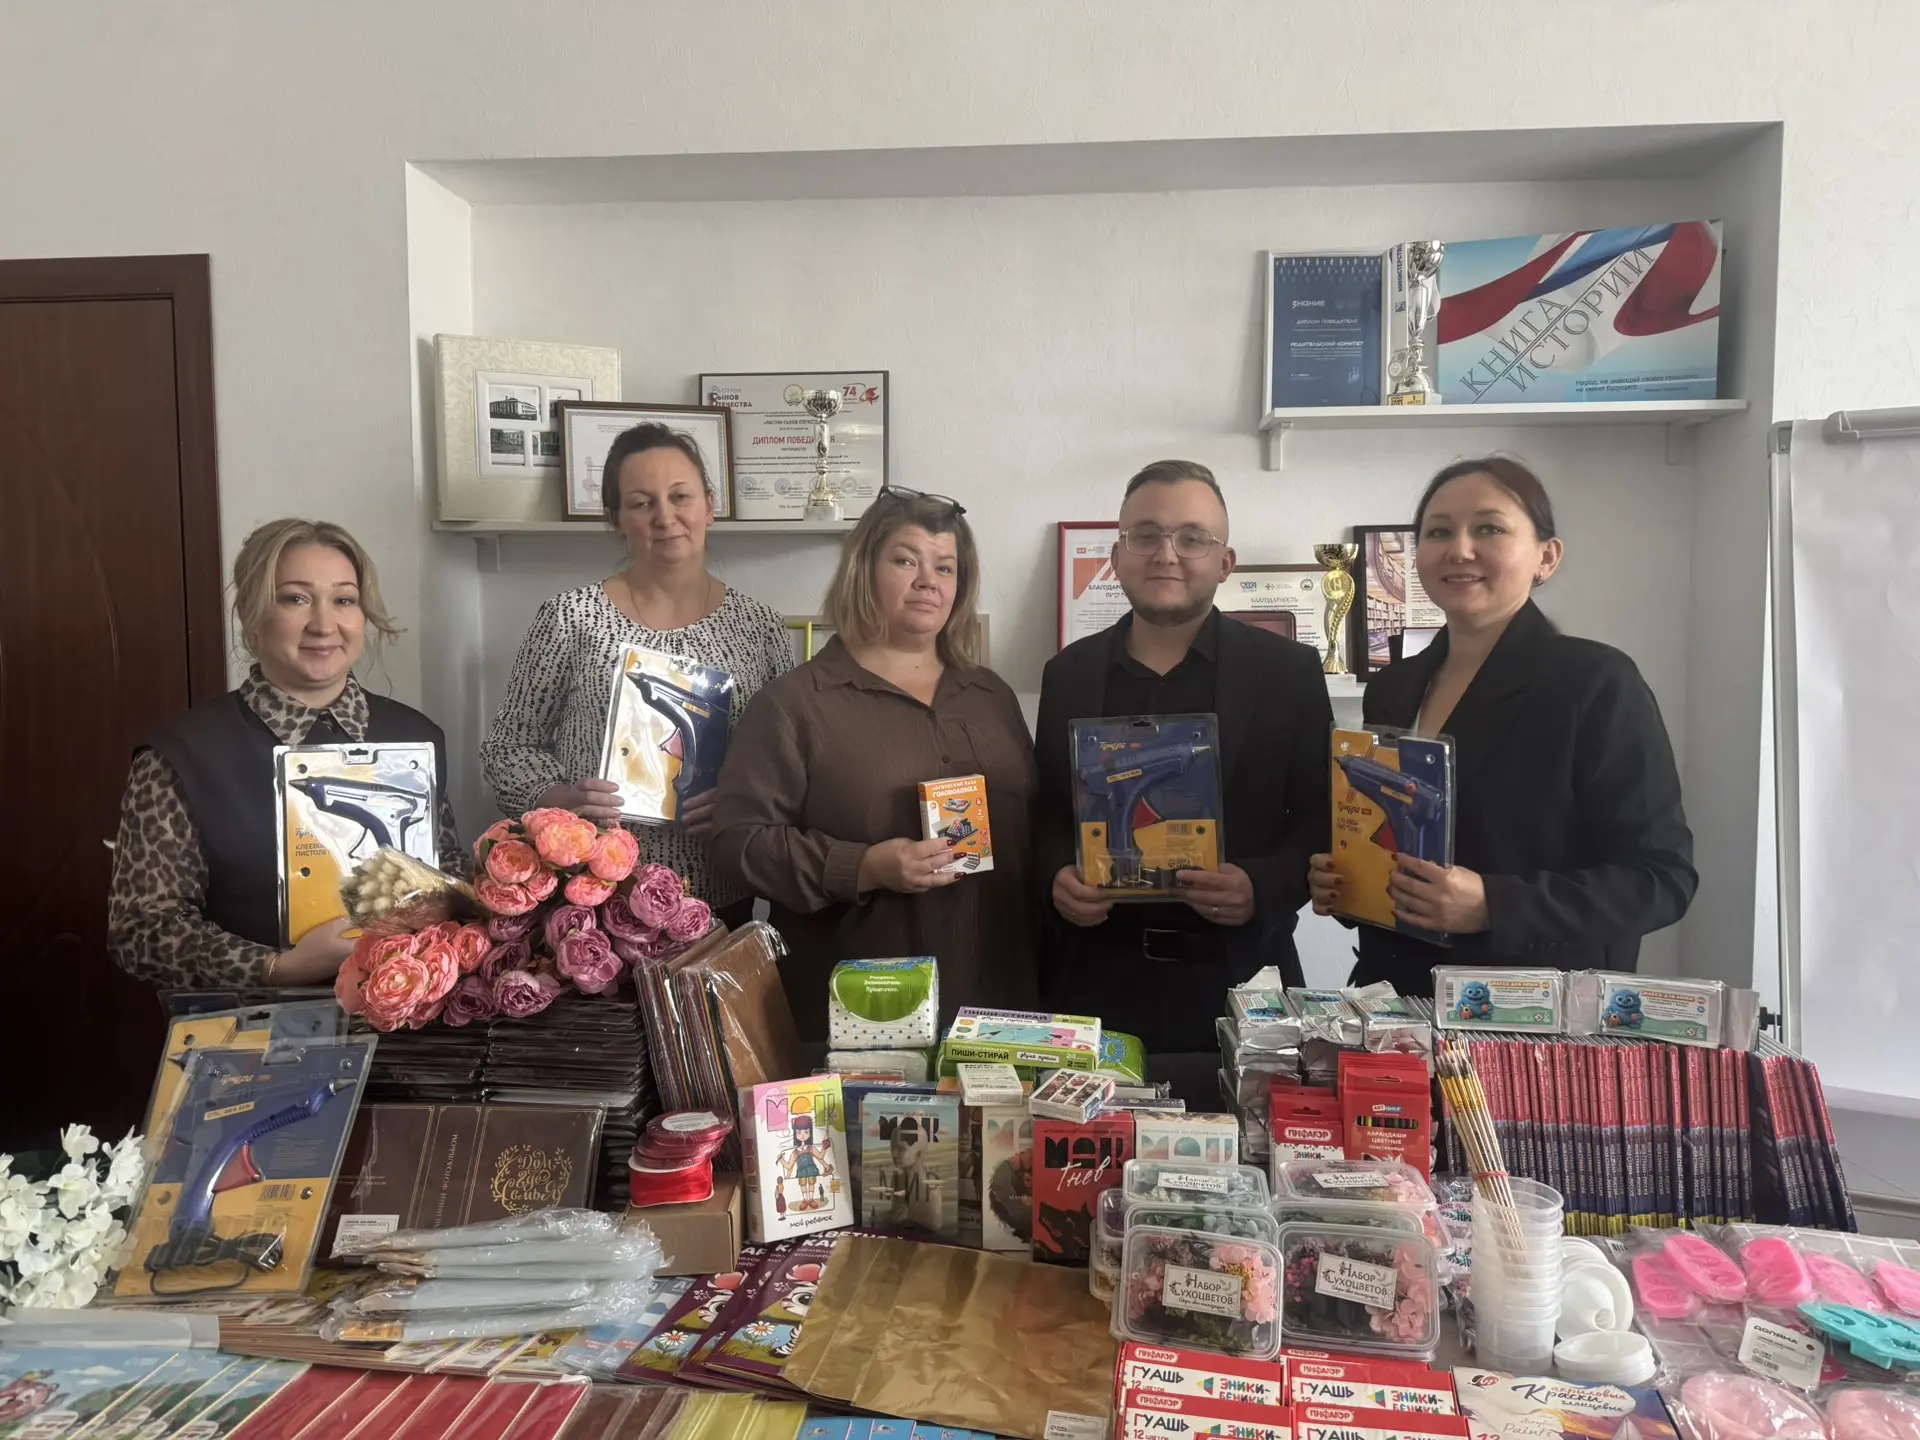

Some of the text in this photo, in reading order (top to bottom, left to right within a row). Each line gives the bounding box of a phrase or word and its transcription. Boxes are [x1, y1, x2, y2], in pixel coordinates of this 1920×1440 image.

[1505, 248, 1654, 392] ИСТОРИИ
[1459, 297, 1566, 396] КНИГА
[843, 386, 857, 397] 74
[753, 436, 835, 445] ДИПЛОМ ПОБЕДИЯ
[964, 1009, 1048, 1020] ПИШИ-СТИРАЙ
[952, 1048, 1009, 1060] ПИШИ-СТИРАЙ
[879, 1116, 939, 1143] МАК
[1288, 1129, 1329, 1139] ПИФАГОР
[1045, 1136, 1124, 1169] МАК
[1339, 1261, 1376, 1281] НАБОР
[1185, 1273, 1221, 1291] НАБОР
[1322, 1268, 1387, 1295] СУХОЦВЕТОВ
[1169, 1280, 1233, 1305] СУХОЦВЕТОВ
[1753, 1324, 1798, 1344] ДОЛЯНА
[1138, 1350, 1175, 1361] ПИФАГОР
[1132, 1365, 1184, 1384] ГУАШЬ
[1303, 1365, 1341, 1376] ПИФАГОР
[1131, 1380, 1141, 1389] 12
[1220, 1378, 1270, 1394] ЭНИКИ-
[1301, 1382, 1354, 1398] ГУАШЬ
[1391, 1390, 1443, 1405] ЭНИКИ-
[1511, 1384, 1602, 1405] Краски
[1551, 1386, 1627, 1400] акриловые
[1140, 1396, 1179, 1407] ПИФАГОР
[1561, 1400, 1624, 1412] глянцевые
[1310, 1408, 1350, 1420] ПИФАГОР
[1134, 1413, 1189, 1432] ГУАШЬ
[1134, 1429, 1144, 1439] 12
[1307, 1428, 1365, 1440] ГУАШЬ
